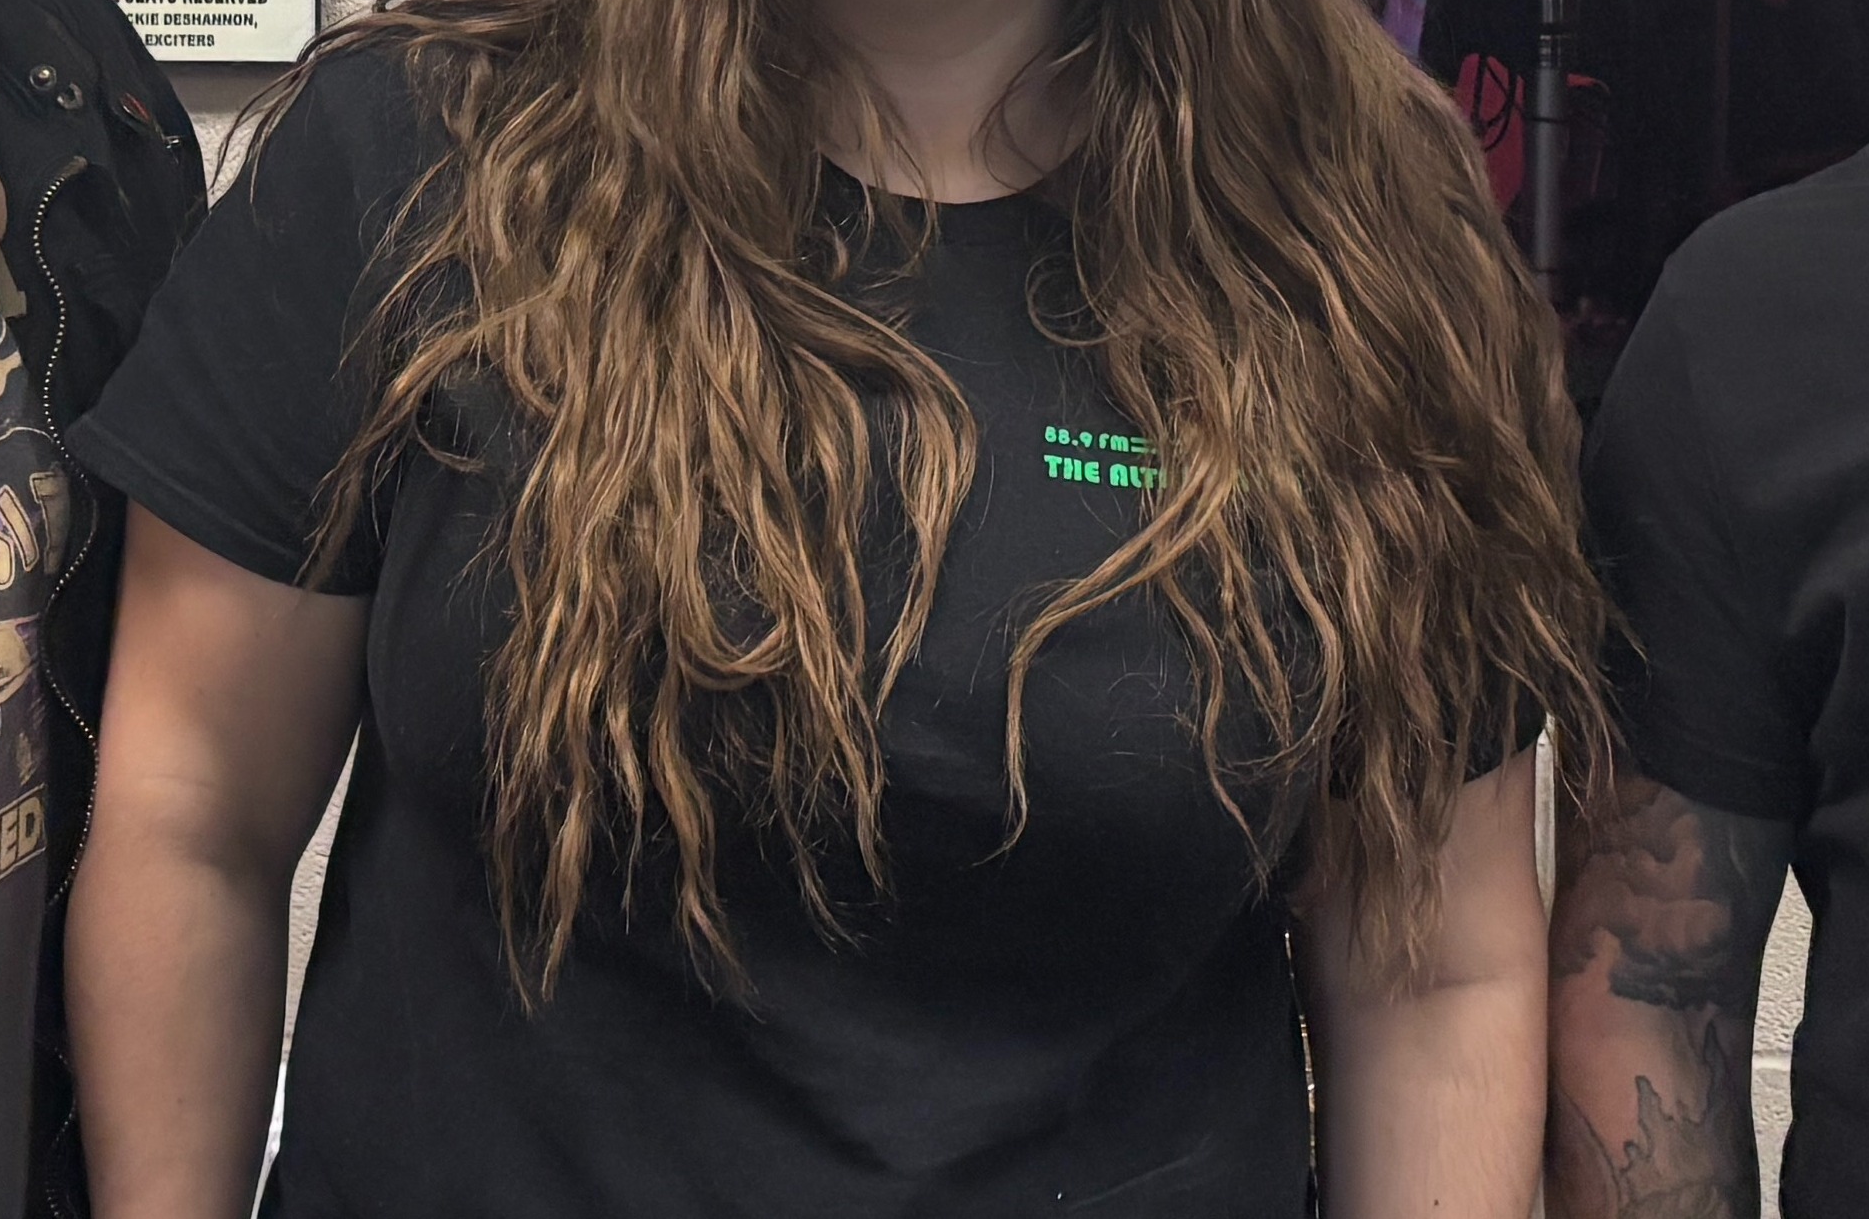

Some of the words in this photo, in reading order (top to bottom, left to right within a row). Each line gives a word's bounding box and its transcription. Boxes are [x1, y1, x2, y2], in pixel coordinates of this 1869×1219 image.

[145, 33, 216, 47] EXCITERS
[1043, 425, 1093, 449] 88.9
[1043, 454, 1100, 484] THE
